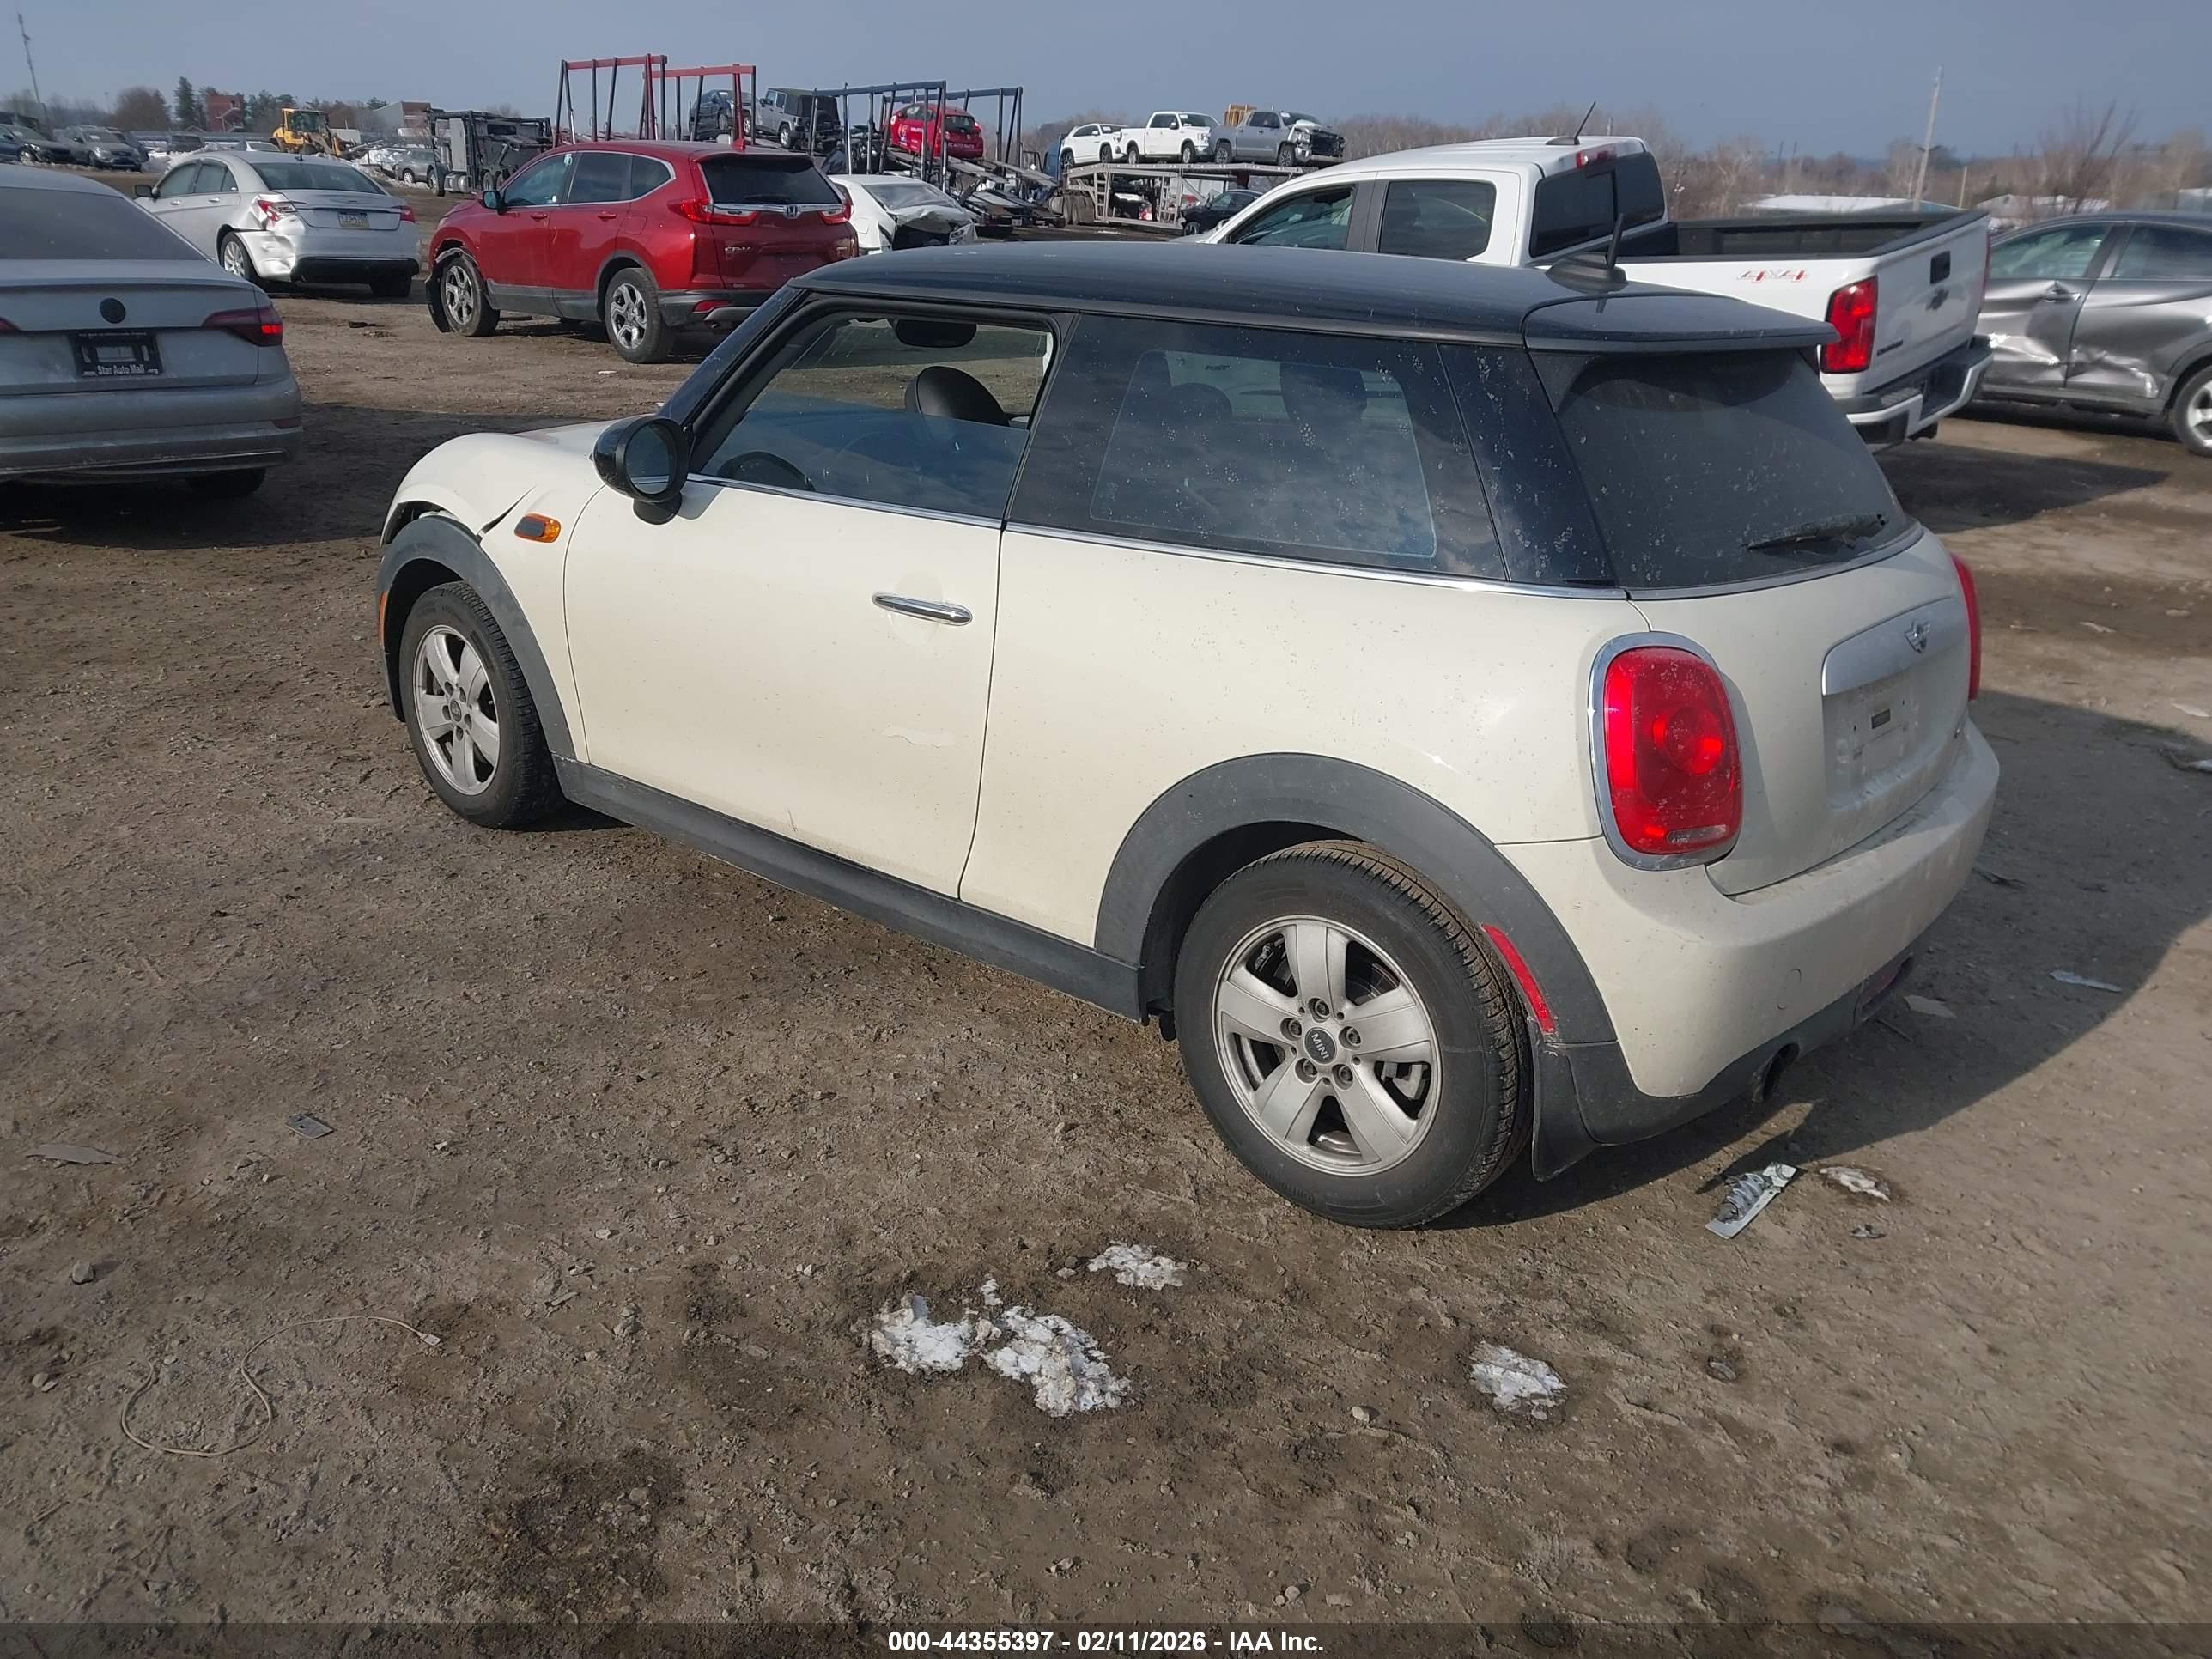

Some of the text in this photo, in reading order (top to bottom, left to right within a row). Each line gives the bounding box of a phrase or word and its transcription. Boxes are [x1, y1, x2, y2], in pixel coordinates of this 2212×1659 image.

[97, 365, 112, 375] Star
[113, 365, 130, 375] Auto
[130, 363, 145, 374] Mall
[1310, 1032, 1330, 1059] MINI
